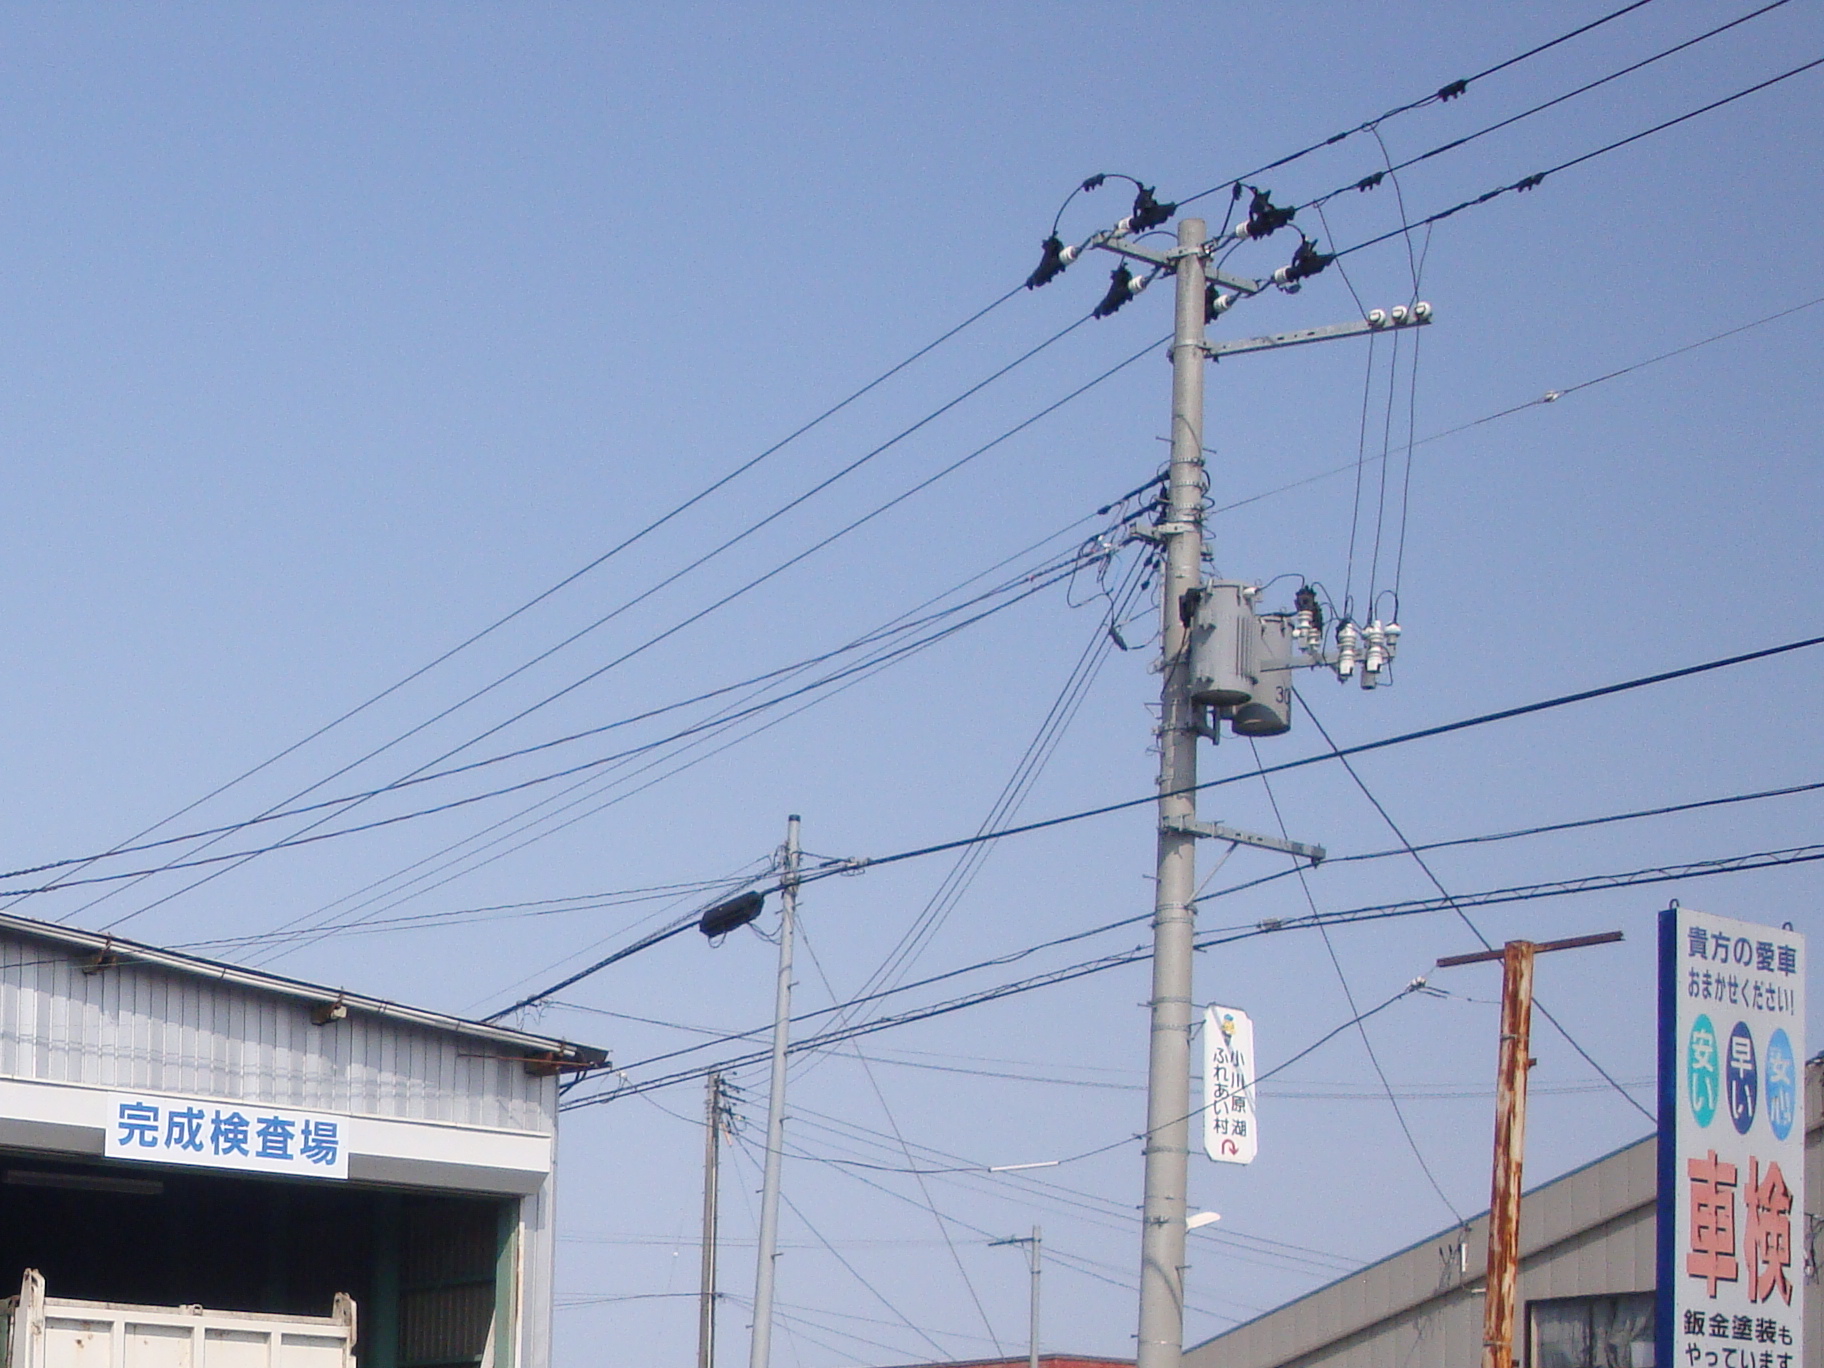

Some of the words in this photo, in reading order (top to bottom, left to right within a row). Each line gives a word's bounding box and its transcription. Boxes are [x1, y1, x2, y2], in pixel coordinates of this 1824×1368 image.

[1687, 926, 1797, 977] 貴方の愛車
[1687, 966, 1795, 1016] おまかせください!
[1212, 1047, 1229, 1135] ふれあい村
[1230, 1050, 1247, 1137] 小川原湖
[1691, 1029, 1715, 1112] 安い
[1730, 1036, 1754, 1119] 早い
[117, 1101, 340, 1166] 完成検査場
[1686, 1149, 1794, 1307] 車検
[1683, 1309, 1794, 1347] 鈑金塗装も
